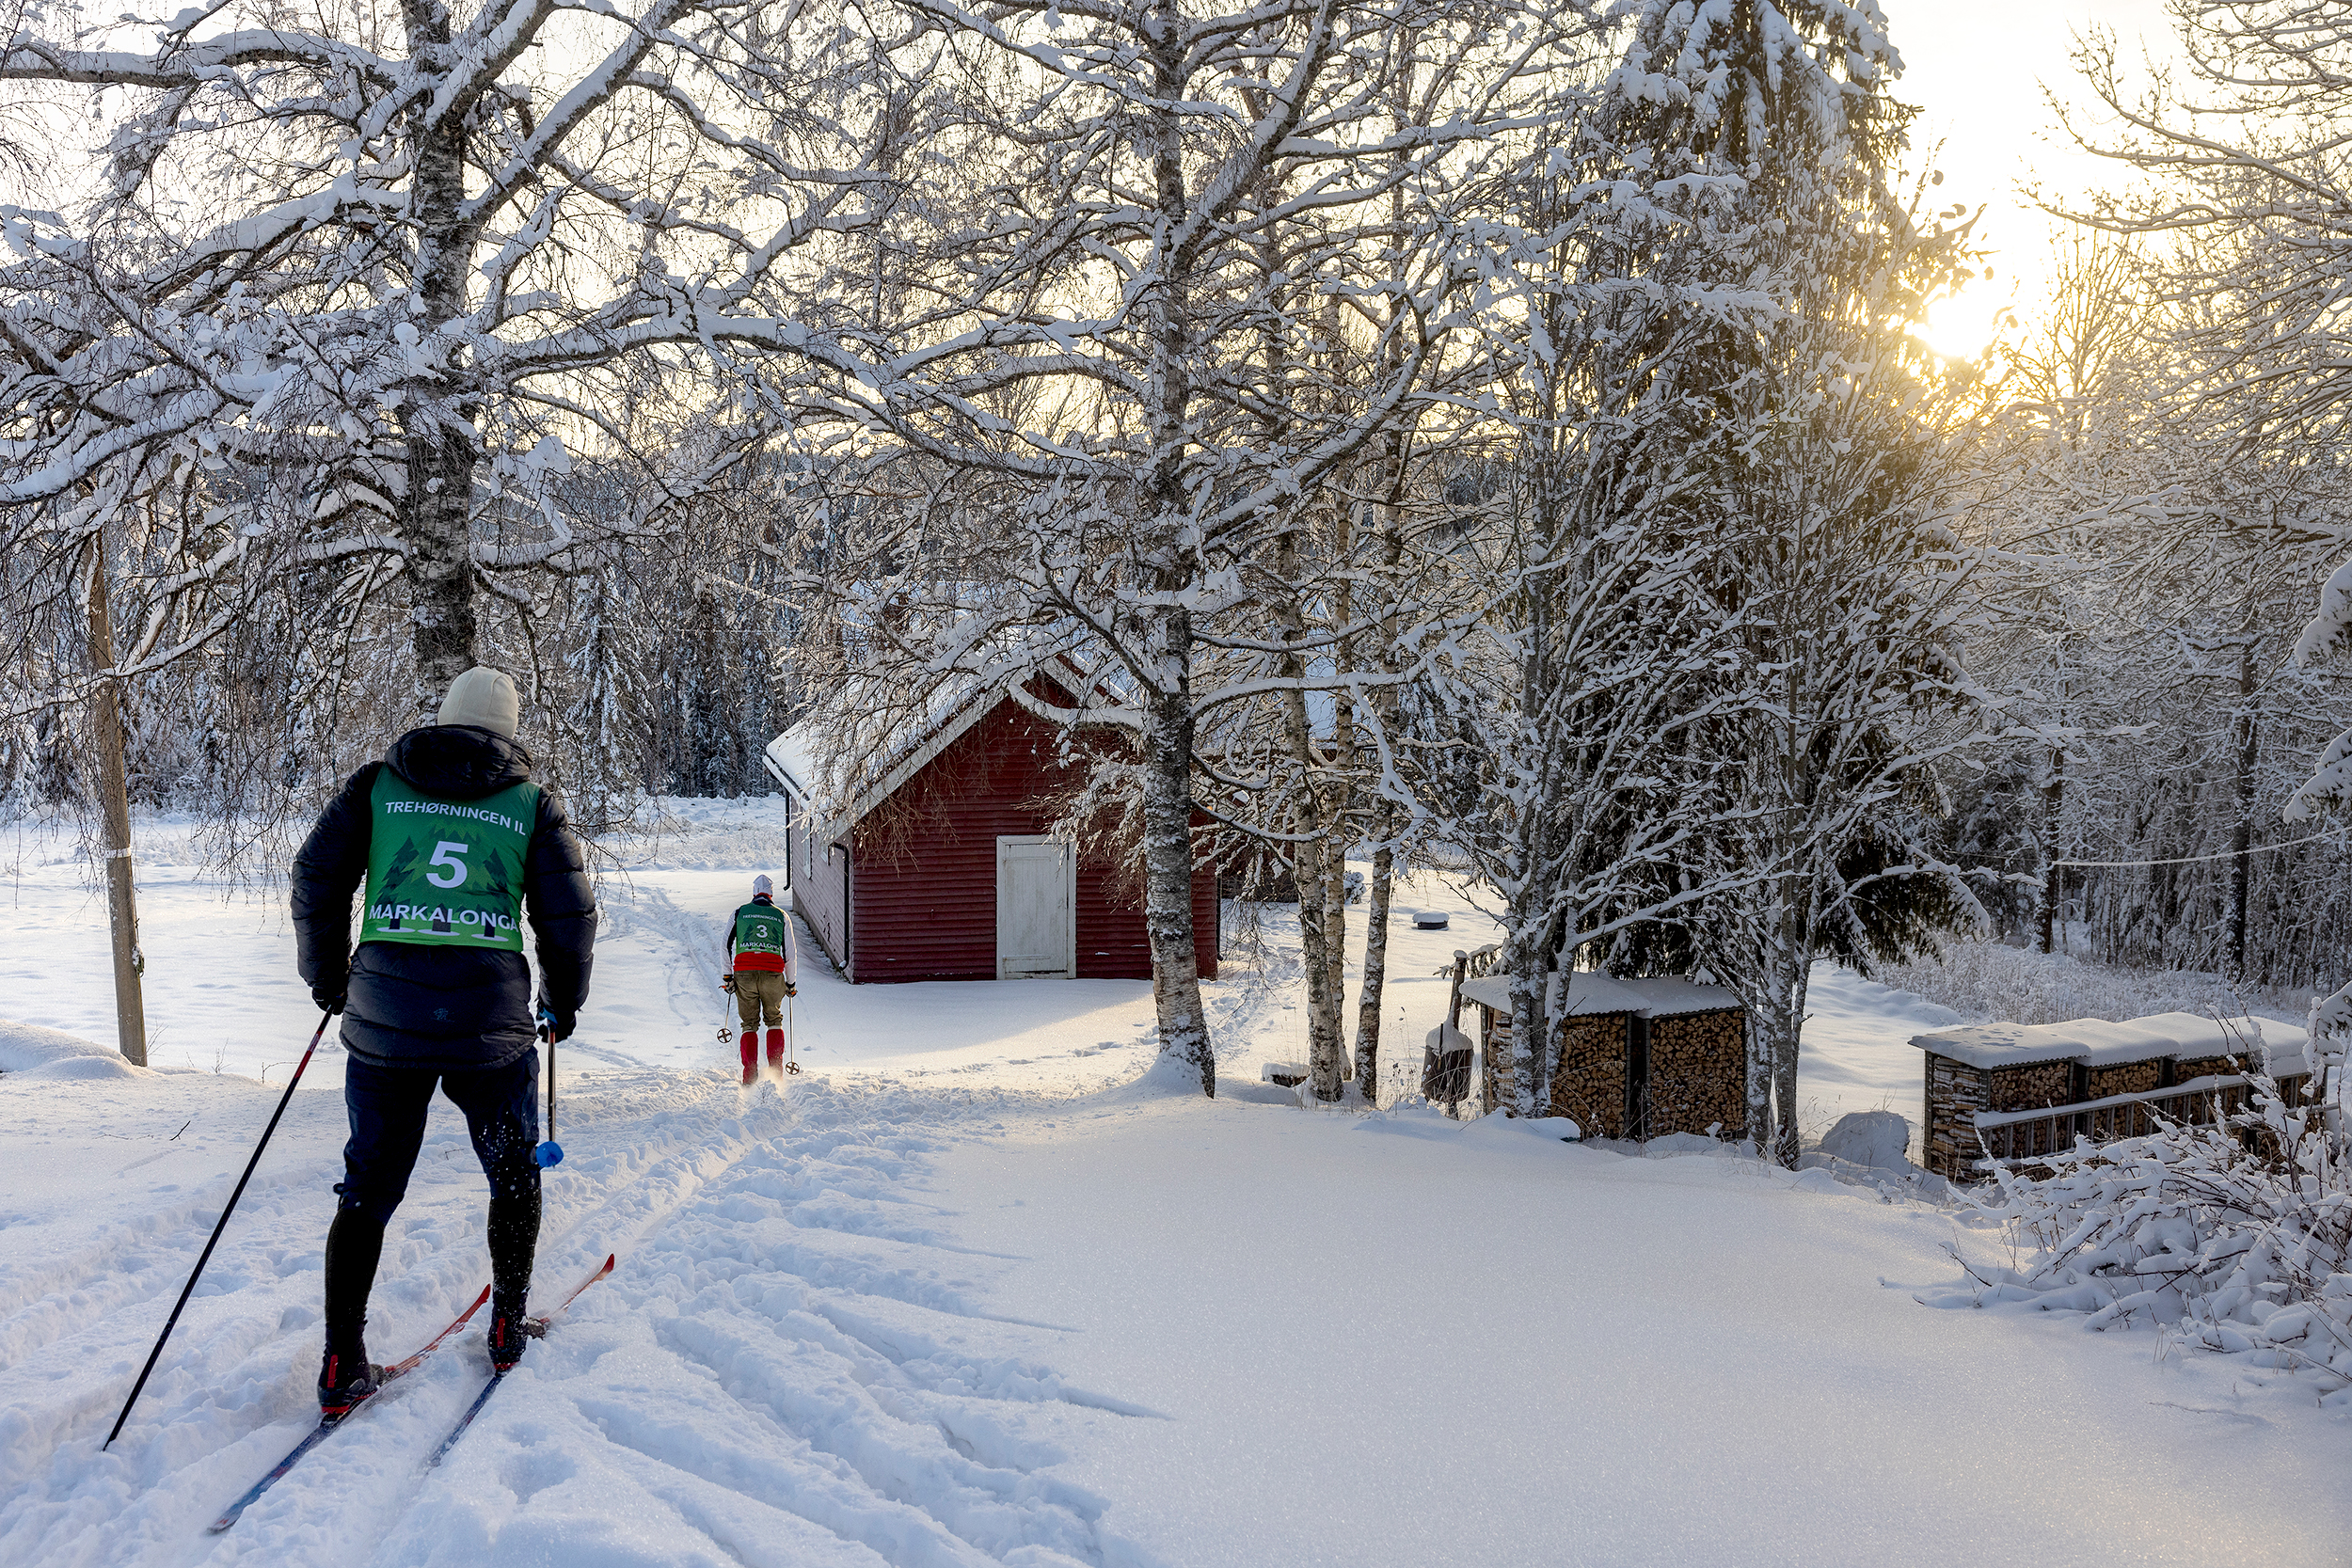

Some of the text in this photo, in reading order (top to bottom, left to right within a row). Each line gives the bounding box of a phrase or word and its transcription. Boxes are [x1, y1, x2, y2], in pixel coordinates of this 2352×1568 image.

[386, 801, 526, 835] TREHØRNINGEN IL
[426, 840, 469, 889] 5
[368, 904, 519, 932] MARKALONGA
[755, 925, 769, 939] 3
